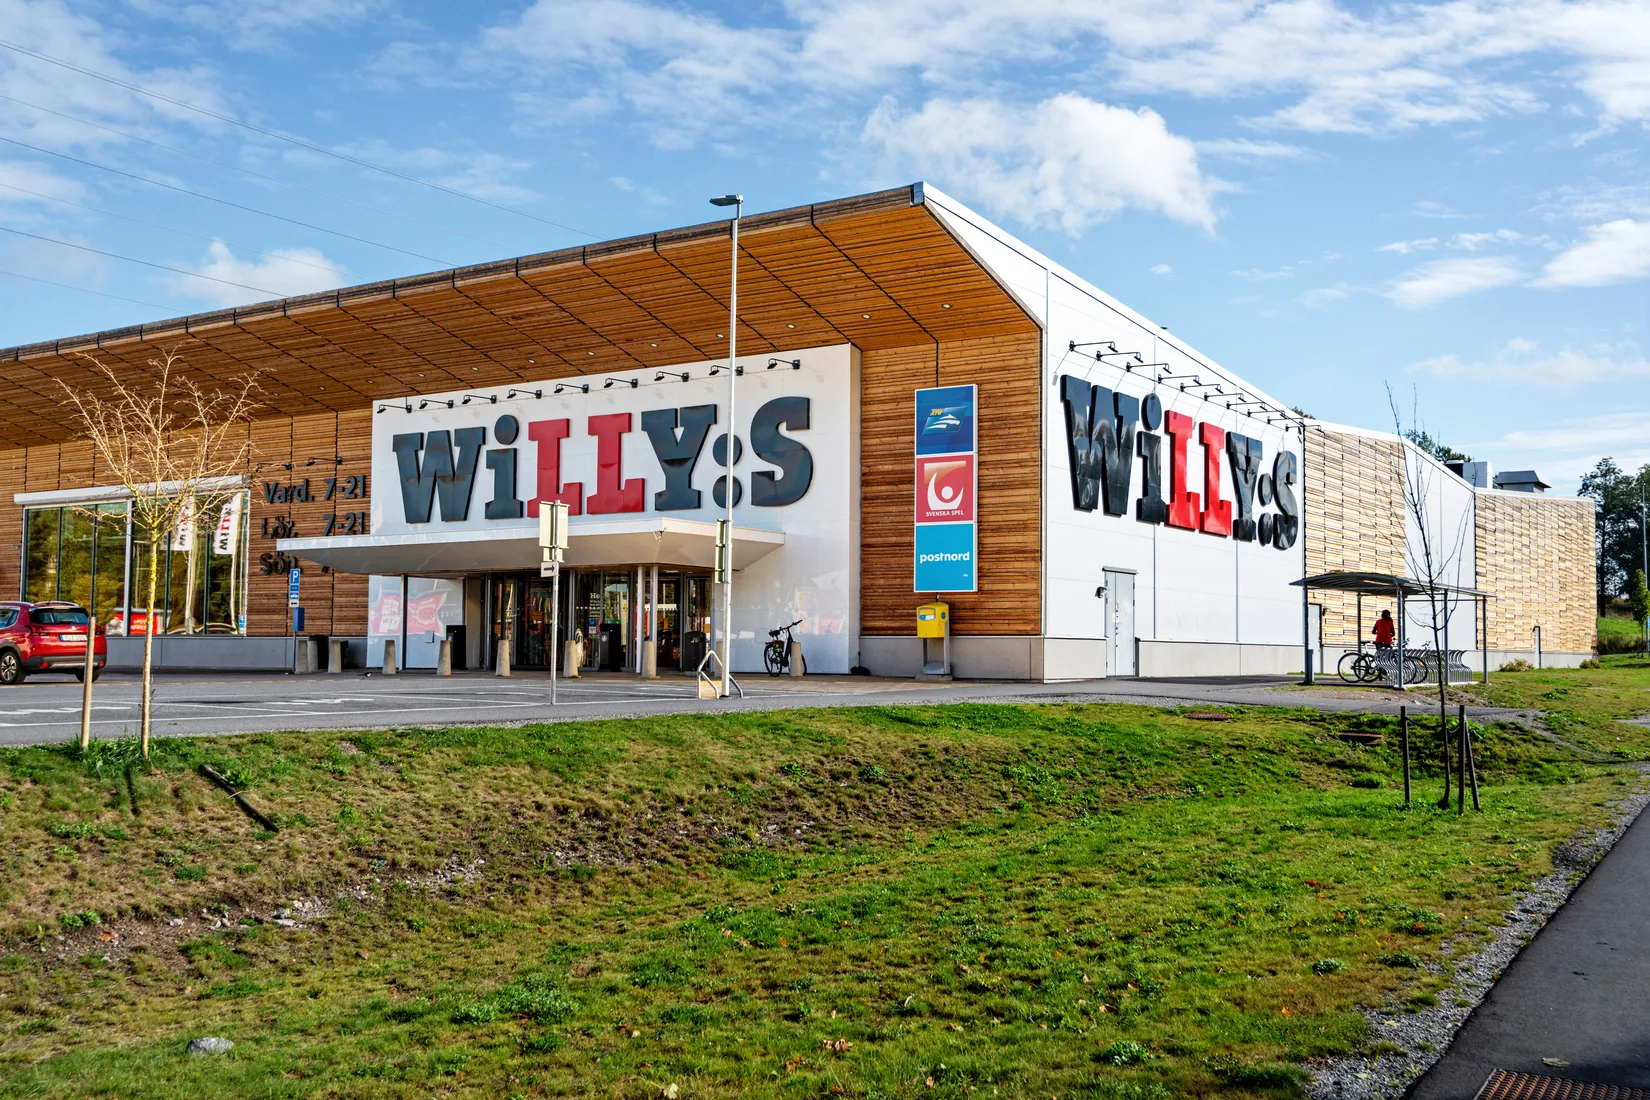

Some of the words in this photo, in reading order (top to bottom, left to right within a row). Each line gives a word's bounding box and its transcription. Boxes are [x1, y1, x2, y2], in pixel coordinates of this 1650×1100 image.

[392, 396, 814, 524] WiLLY:S
[1060, 375, 1298, 550] WiLLY:S
[264, 478, 314, 504] Vard.
[324, 475, 366, 501] 7-21
[261, 515, 298, 539] Lör.
[322, 512, 365, 537] 7-21
[919, 551, 970, 564] postnord
[292, 570, 299, 583] P
